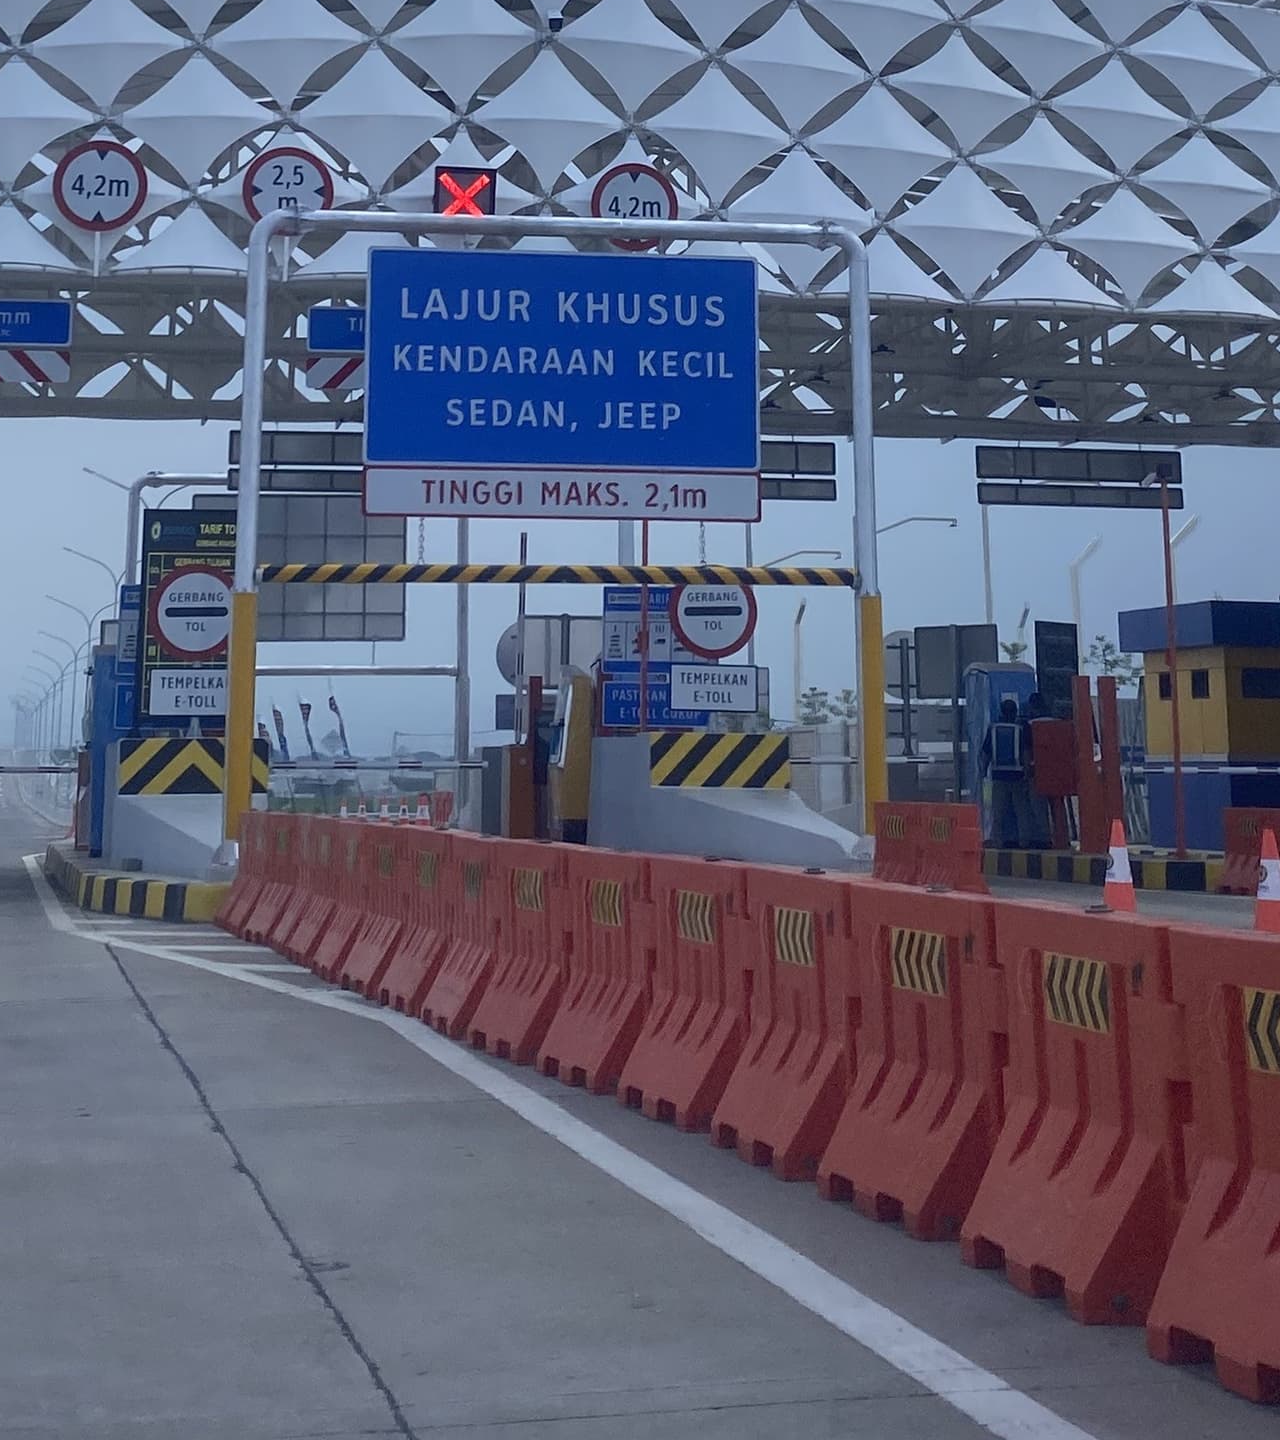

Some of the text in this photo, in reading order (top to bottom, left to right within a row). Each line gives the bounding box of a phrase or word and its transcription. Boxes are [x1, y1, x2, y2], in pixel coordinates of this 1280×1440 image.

[272, 164, 305, 190] 2,5
[70, 174, 130, 201] 4,2m
[607, 194, 662, 219] 4,2m
[401, 287, 727, 328] LAJUR KHUSUS
[393, 344, 735, 379] KENDARAAN KECIL
[445, 398, 682, 433] SEDAN, JEEP
[422, 480, 707, 511] TINGGI MAKS. 2,1m
[168, 592, 225, 603] GERBANG
[686, 592, 739, 603] GERBANG
[185, 621, 207, 632] TOL
[704, 620, 723, 631] TOL
[160, 676, 227, 690] TEMPELKA
[680, 672, 748, 686] TEMPELKAN
[174, 695, 218, 708] E-TOLL
[612, 689, 667, 703] PASTAN
[693, 691, 734, 704] E-TOLL
